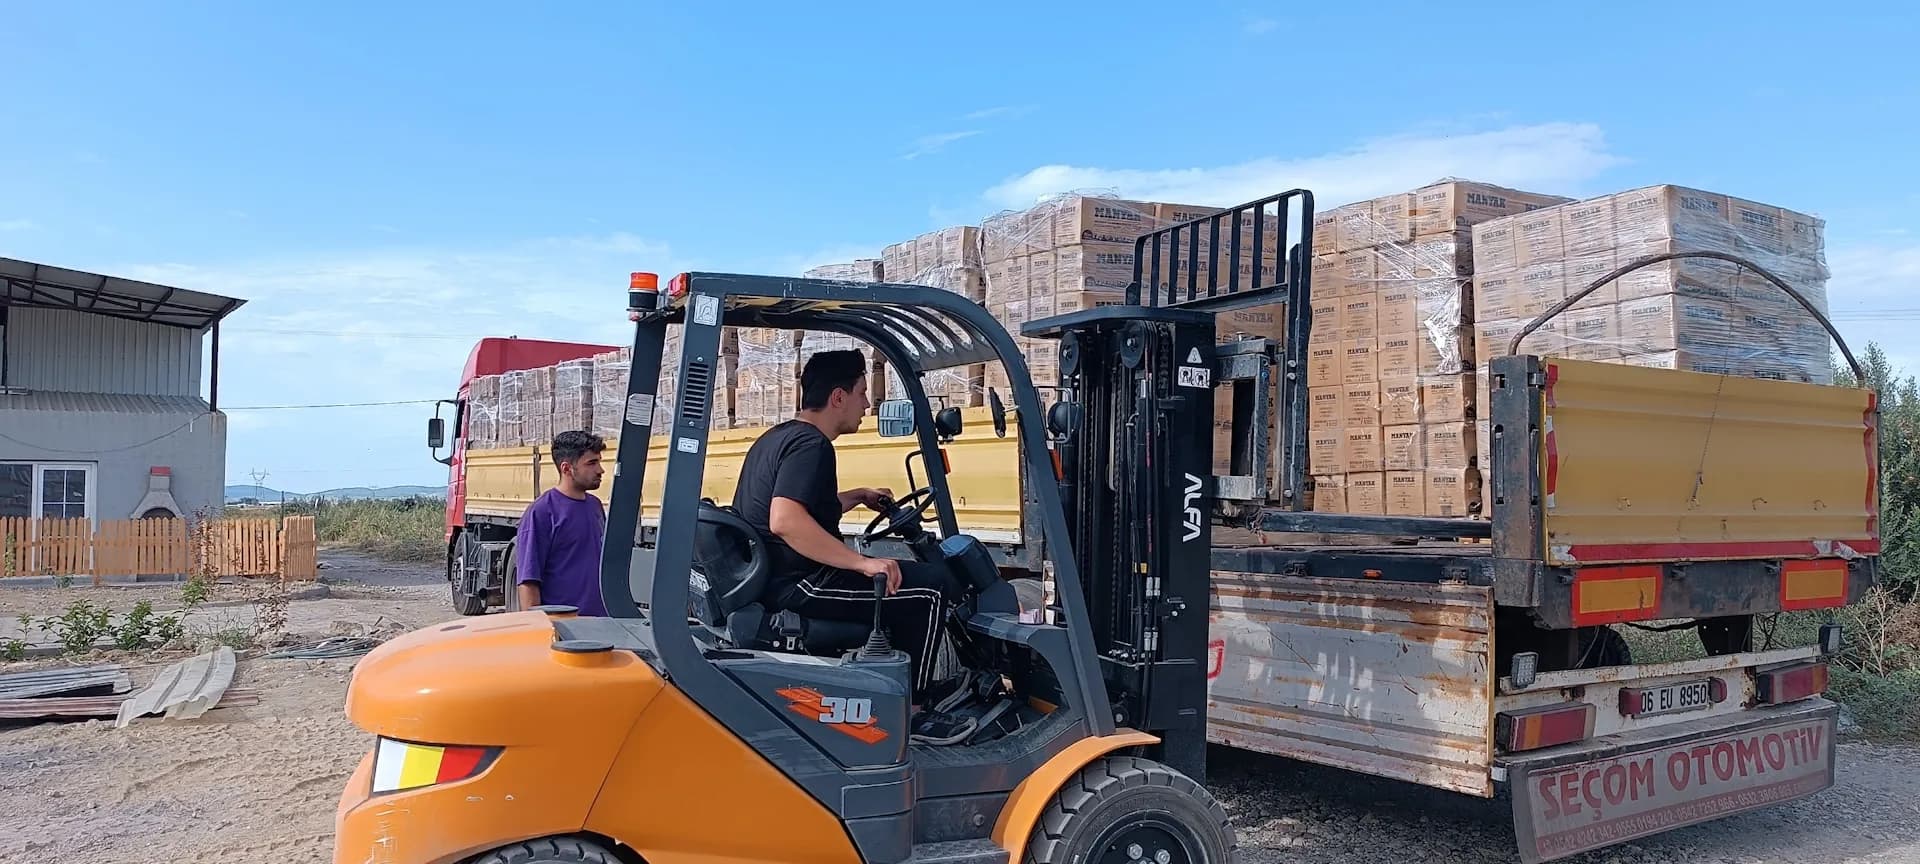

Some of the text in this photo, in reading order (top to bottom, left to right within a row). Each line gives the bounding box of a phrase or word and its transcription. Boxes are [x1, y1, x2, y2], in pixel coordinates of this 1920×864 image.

[1183, 473, 1203, 542] ALFA
[819, 697, 871, 723] 30
[1641, 684, 1707, 712] 06 EU 8950
